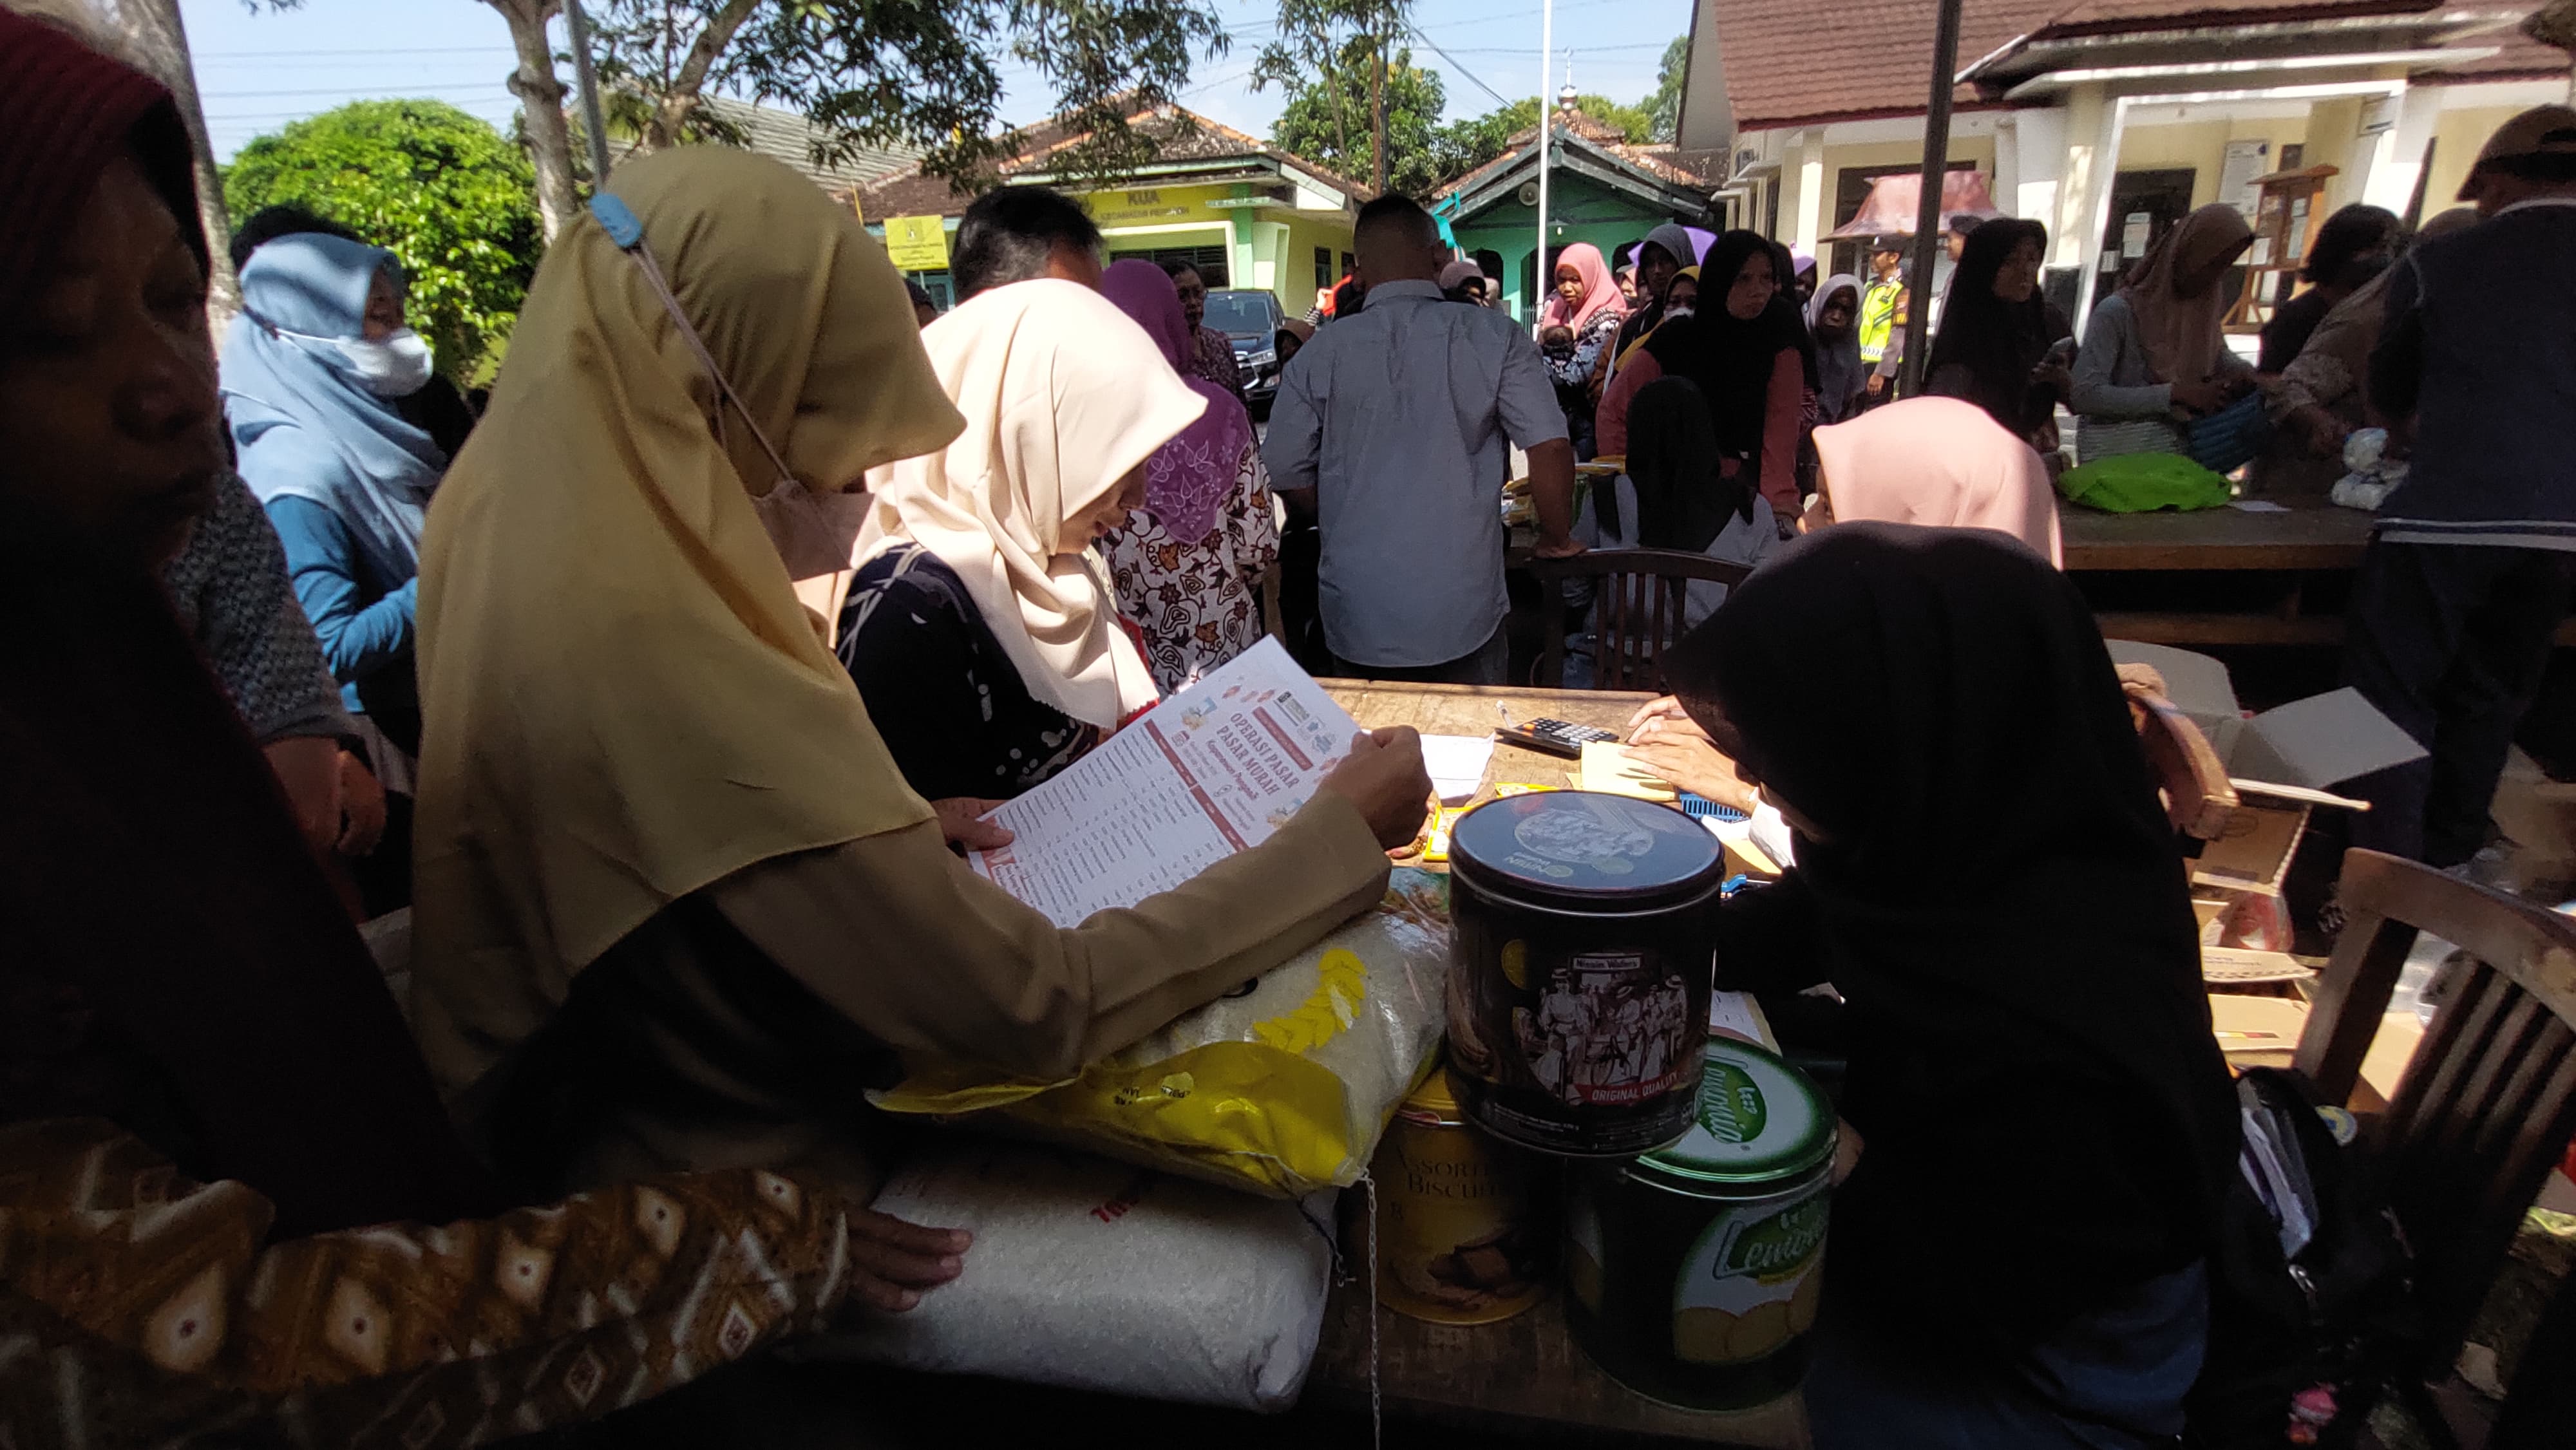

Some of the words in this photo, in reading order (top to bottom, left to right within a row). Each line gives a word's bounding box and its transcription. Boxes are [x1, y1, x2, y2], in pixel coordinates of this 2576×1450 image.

[1215, 724, 1250, 762] PASAR
[1241, 755, 1281, 796] MURAH
[1228, 710, 1272, 758] OPERASI
[1264, 751, 1300, 789] PASAR
[1592, 1088, 1639, 1102] ORIGINAL
[1642, 1071, 1678, 1097] QUALITY
